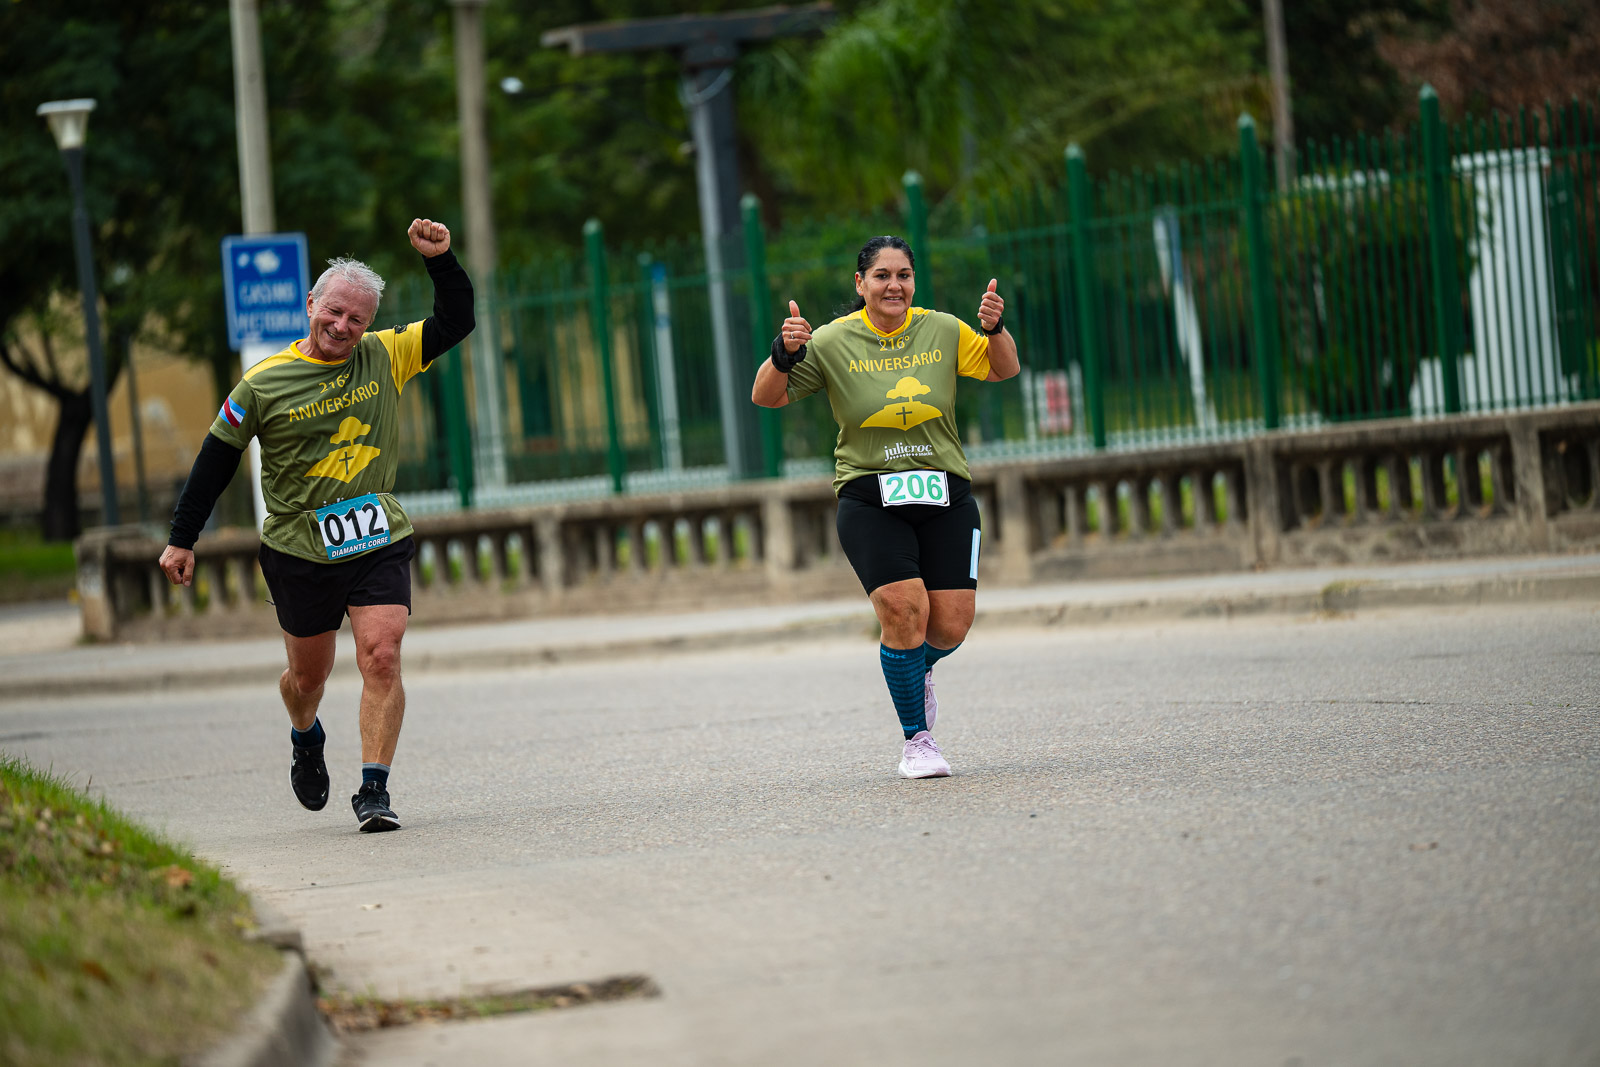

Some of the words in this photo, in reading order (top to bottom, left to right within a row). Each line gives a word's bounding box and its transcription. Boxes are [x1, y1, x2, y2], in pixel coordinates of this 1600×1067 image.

[848, 348, 943, 373] ANIVERSARIO
[288, 380, 380, 423] ANIVERSARIO
[884, 442, 933, 462] julicroc
[885, 474, 943, 502] 206
[323, 501, 385, 547] 012
[331, 542, 367, 558] DIAMANTE
[367, 536, 389, 548] CORRE
